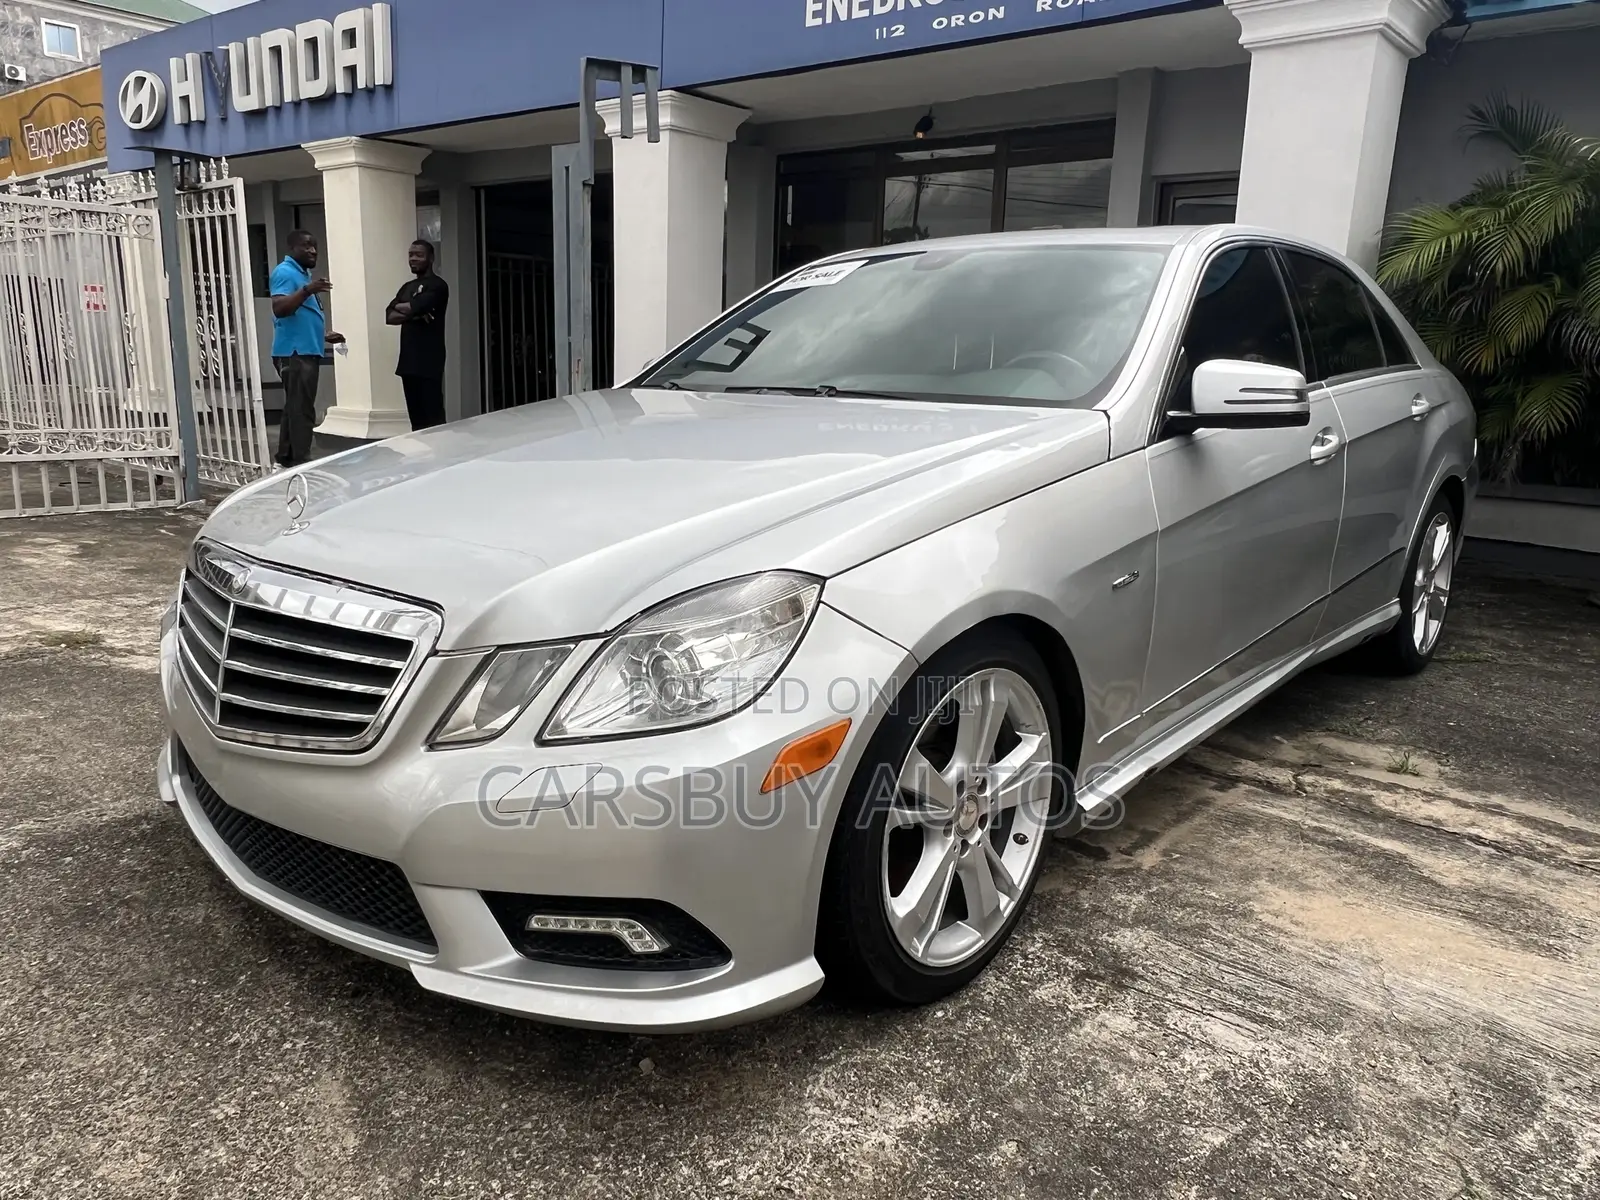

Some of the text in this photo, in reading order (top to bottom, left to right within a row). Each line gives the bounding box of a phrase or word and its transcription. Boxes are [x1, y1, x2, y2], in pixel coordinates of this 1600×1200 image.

[932, 6, 1005, 29] ORON
[169, 2, 393, 125] HYUNDAI
[23, 117, 90, 164] Express
